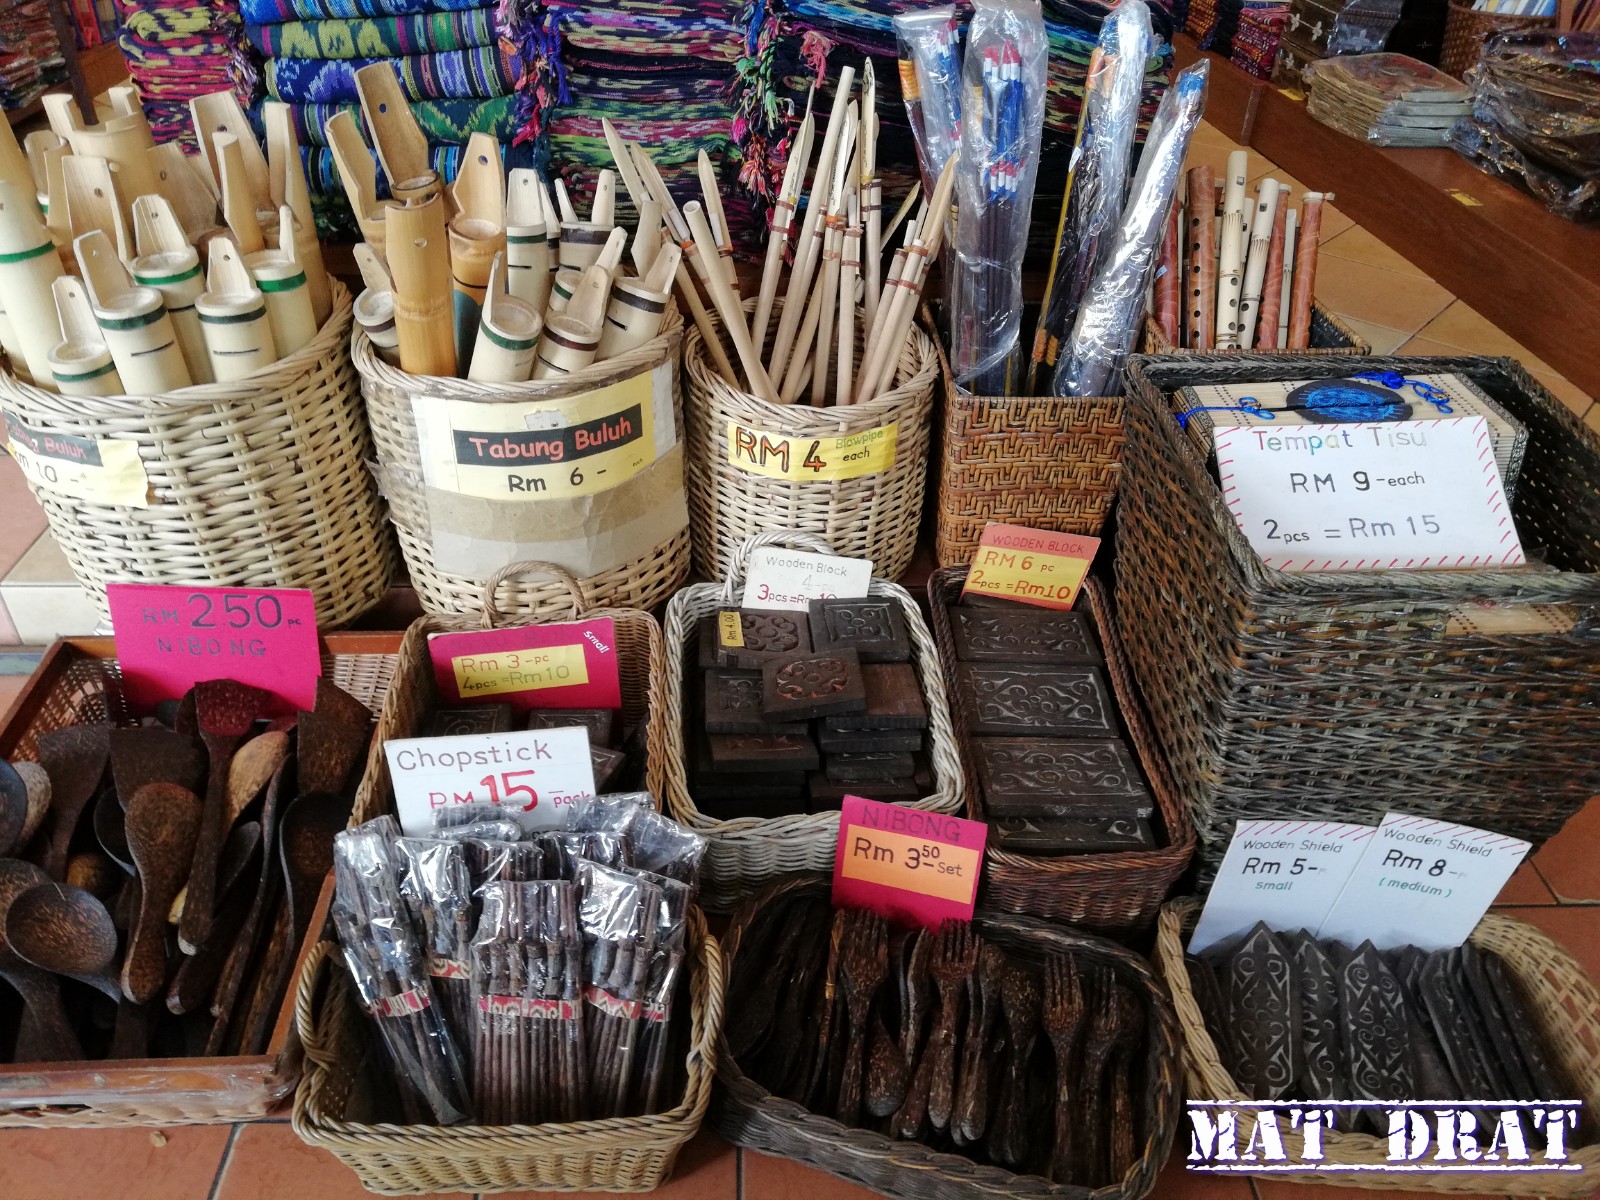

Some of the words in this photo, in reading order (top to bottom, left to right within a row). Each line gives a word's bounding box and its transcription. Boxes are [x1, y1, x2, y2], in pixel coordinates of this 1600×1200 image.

[43, 436, 87, 459] Buluh
[469, 434, 563, 461] Tabung
[575, 416, 631, 450] Buluh
[735, 426, 790, 473] RM
[802, 440, 827, 472] 4
[835, 429, 884, 449] Blowpipe
[1252, 429, 1353, 455] Tempat
[1367, 426, 1428, 448] Tisu
[842, 446, 870, 462] each
[36, 461, 58, 483] 10
[508, 475, 546, 492] Rm
[570, 467, 584, 486] 6
[1290, 472, 1336, 493] RM
[1263, 519, 1310, 544] 2pcs
[993, 534, 1045, 549] WOODEN
[1047, 540, 1085, 554] BLOCK
[766, 556, 814, 570] Wooden
[816, 563, 847, 577] Block
[984, 550, 1016, 568] RM
[1021, 556, 1034, 571] 6
[1040, 564, 1055, 573] pc
[141, 607, 179, 625] RM
[287, 618, 302, 629] pc
[157, 636, 267, 657] NIBONG
[582, 630, 610, 654] Small
[461, 656, 499, 673] Rm
[463, 676, 497, 691] 4pcs
[396, 739, 553, 772] Chopstick
[480, 769, 538, 813] 15
[862, 805, 961, 842] NIBONG
[853, 837, 894, 863] Rm
[1242, 839, 1294, 851] Wooden
[1300, 839, 1343, 854] Shield
[1383, 828, 1442, 848] Wooden
[1446, 839, 1492, 858] Shield
[1241, 857, 1280, 875] Rm
[1382, 849, 1422, 871] Rm
[1255, 880, 1293, 892] small
